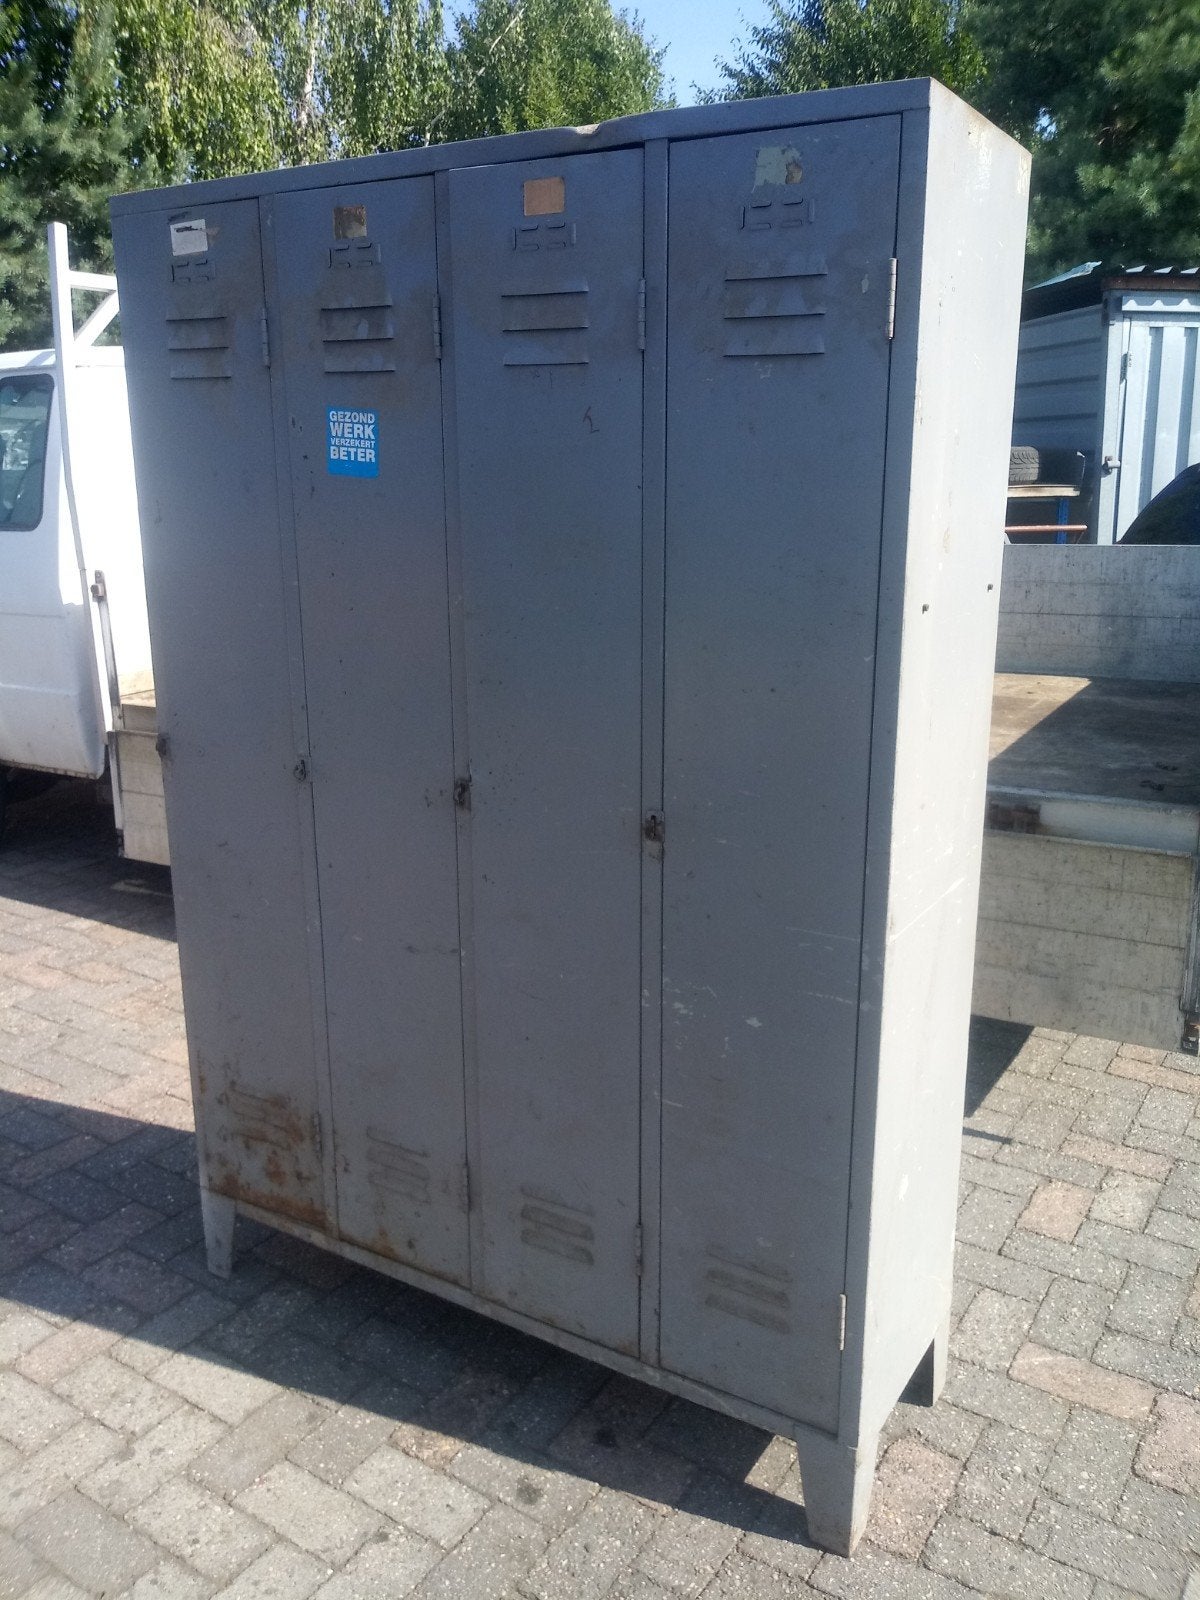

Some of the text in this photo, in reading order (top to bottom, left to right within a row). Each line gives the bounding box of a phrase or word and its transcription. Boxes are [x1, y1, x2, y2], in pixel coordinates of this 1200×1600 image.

[329, 411, 375, 424] GEZOND
[329, 422, 376, 440] WERK
[330, 437, 376, 449] VERZEKERT
[329, 446, 376, 463] BETER
